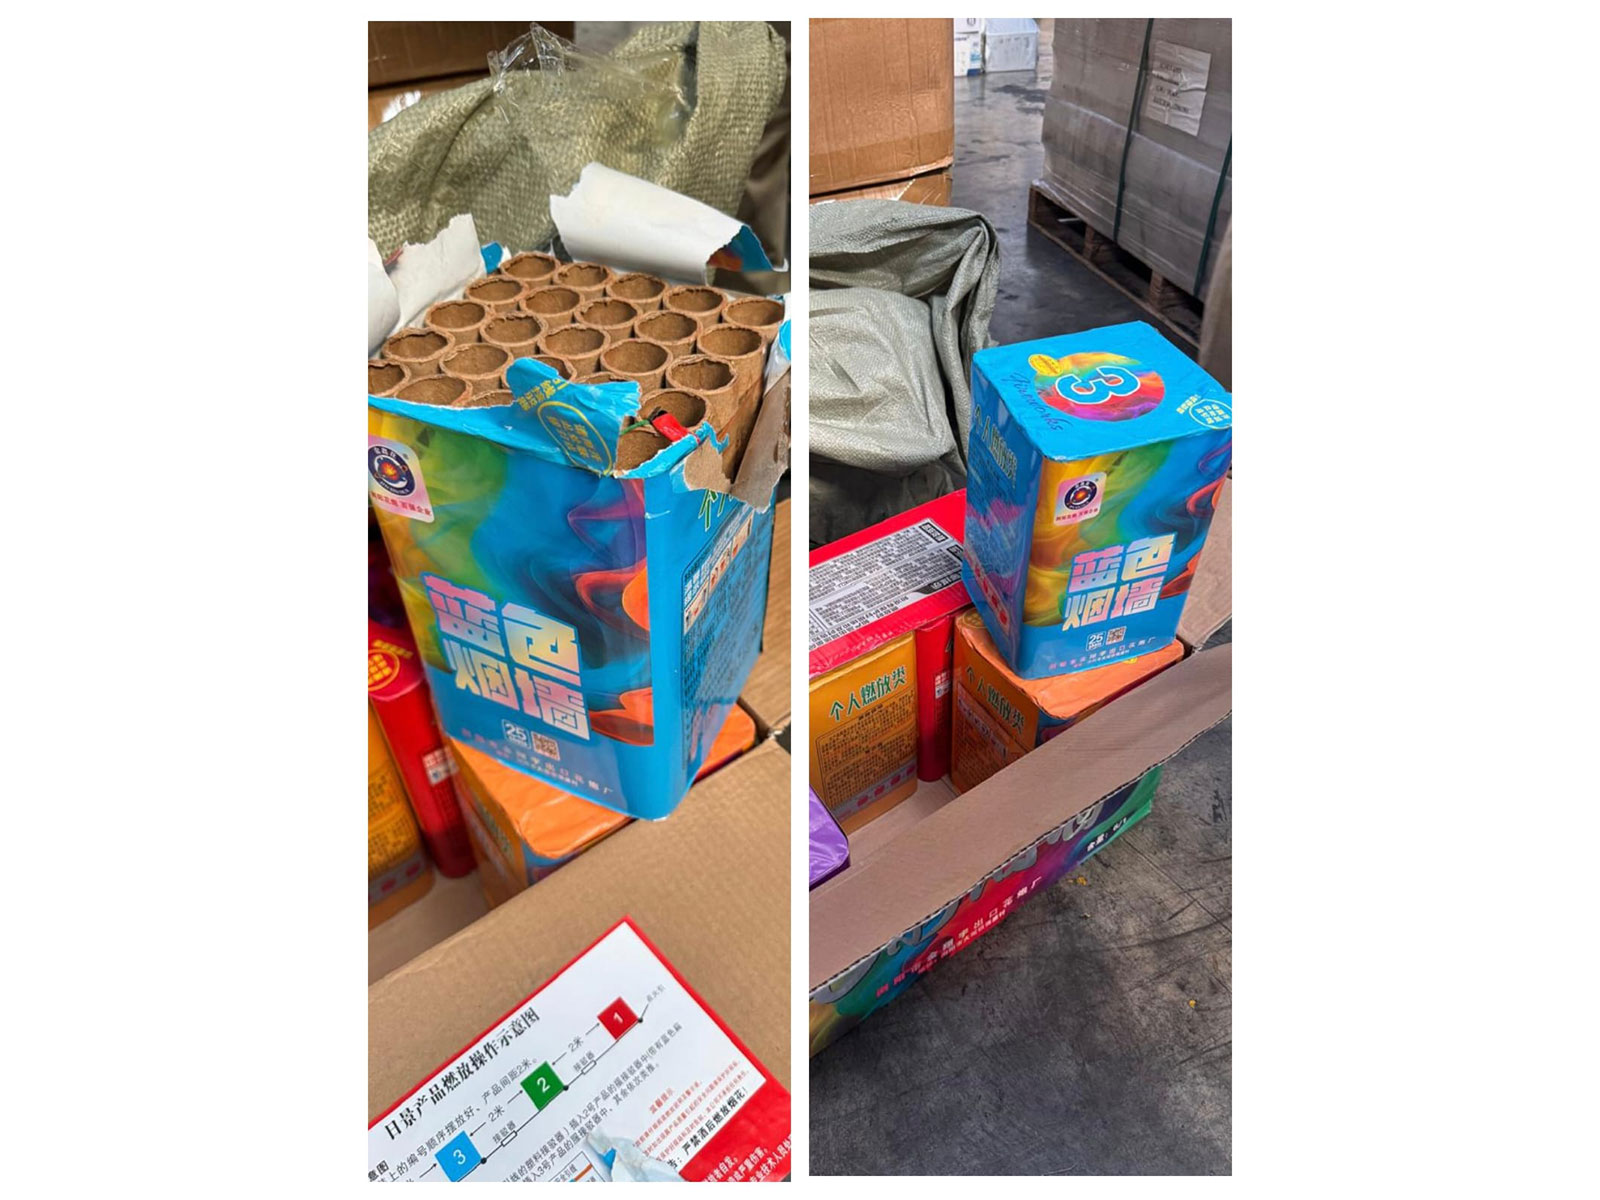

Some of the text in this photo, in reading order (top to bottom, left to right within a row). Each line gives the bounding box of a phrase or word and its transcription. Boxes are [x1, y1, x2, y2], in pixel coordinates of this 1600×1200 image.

[1056, 366, 1141, 404] 3
[1069, 532, 1176, 593] 蓝色
[1061, 576, 1166, 632] 烟墙
[423, 573, 581, 687] 蓝色
[1088, 634, 1105, 645] 25
[449, 641, 590, 741] 烟墙
[829, 665, 907, 722] 个人燃放类
[504, 722, 527, 741] 25
[613, 1012, 624, 1024] 1
[568, 1036, 584, 1052] 2米
[384, 1007, 541, 1141] 日景产品燃放操作示意图
[573, 1051, 596, 1073] 接驳器
[536, 1077, 550, 1093] 2
[378, 1057, 539, 1182] 上的编号顺序摆放好、产品间距2米。
[488, 1105, 506, 1123] 2米
[492, 1120, 517, 1144] 接驳器
[453, 1149, 467, 1166] 3
